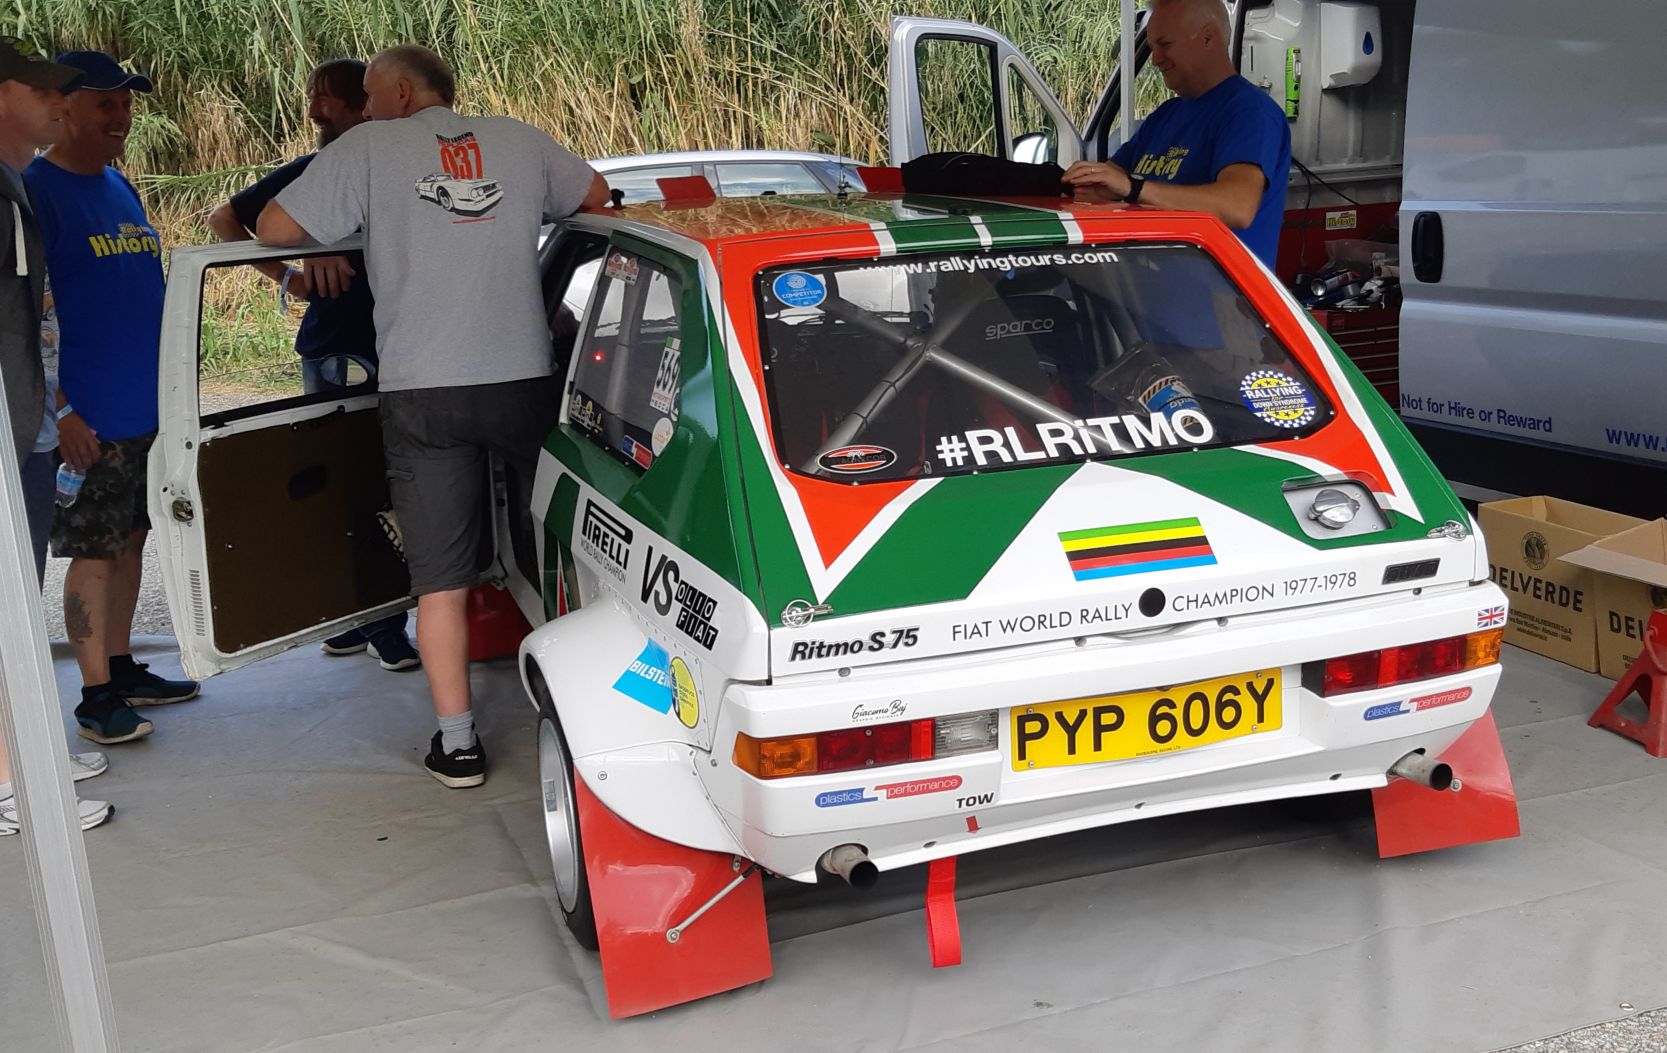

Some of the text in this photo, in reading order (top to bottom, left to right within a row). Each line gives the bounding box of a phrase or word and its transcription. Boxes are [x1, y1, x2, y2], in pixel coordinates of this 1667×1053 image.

[440, 143, 483, 180] 037
[859, 251, 1119, 275] www.rallyingtours.com
[985, 318, 1054, 337] sparco
[1253, 398, 1309, 409] DOWN SYNDROME
[1401, 393, 1552, 433] Not for Hire or Reward
[936, 409, 1214, 467] #RLRiTMO
[582, 498, 633, 571] PIRELLI
[604, 555, 627, 585] CHAMPION
[641, 545, 680, 617] VS
[676, 582, 717, 620] OLIO
[953, 571, 1357, 642] FIAT WORLD RALLY CHAMPION 1977-1978
[677, 610, 717, 648] FIAT
[789, 627, 920, 662] Ritmo S 75
[852, 699, 908, 720] Giacomo Baj
[1016, 677, 1275, 761] PYP 606Y
[1367, 690, 1470, 719] plastics performance
[819, 778, 958, 806] plastics performance
[956, 792, 995, 809] TOW
